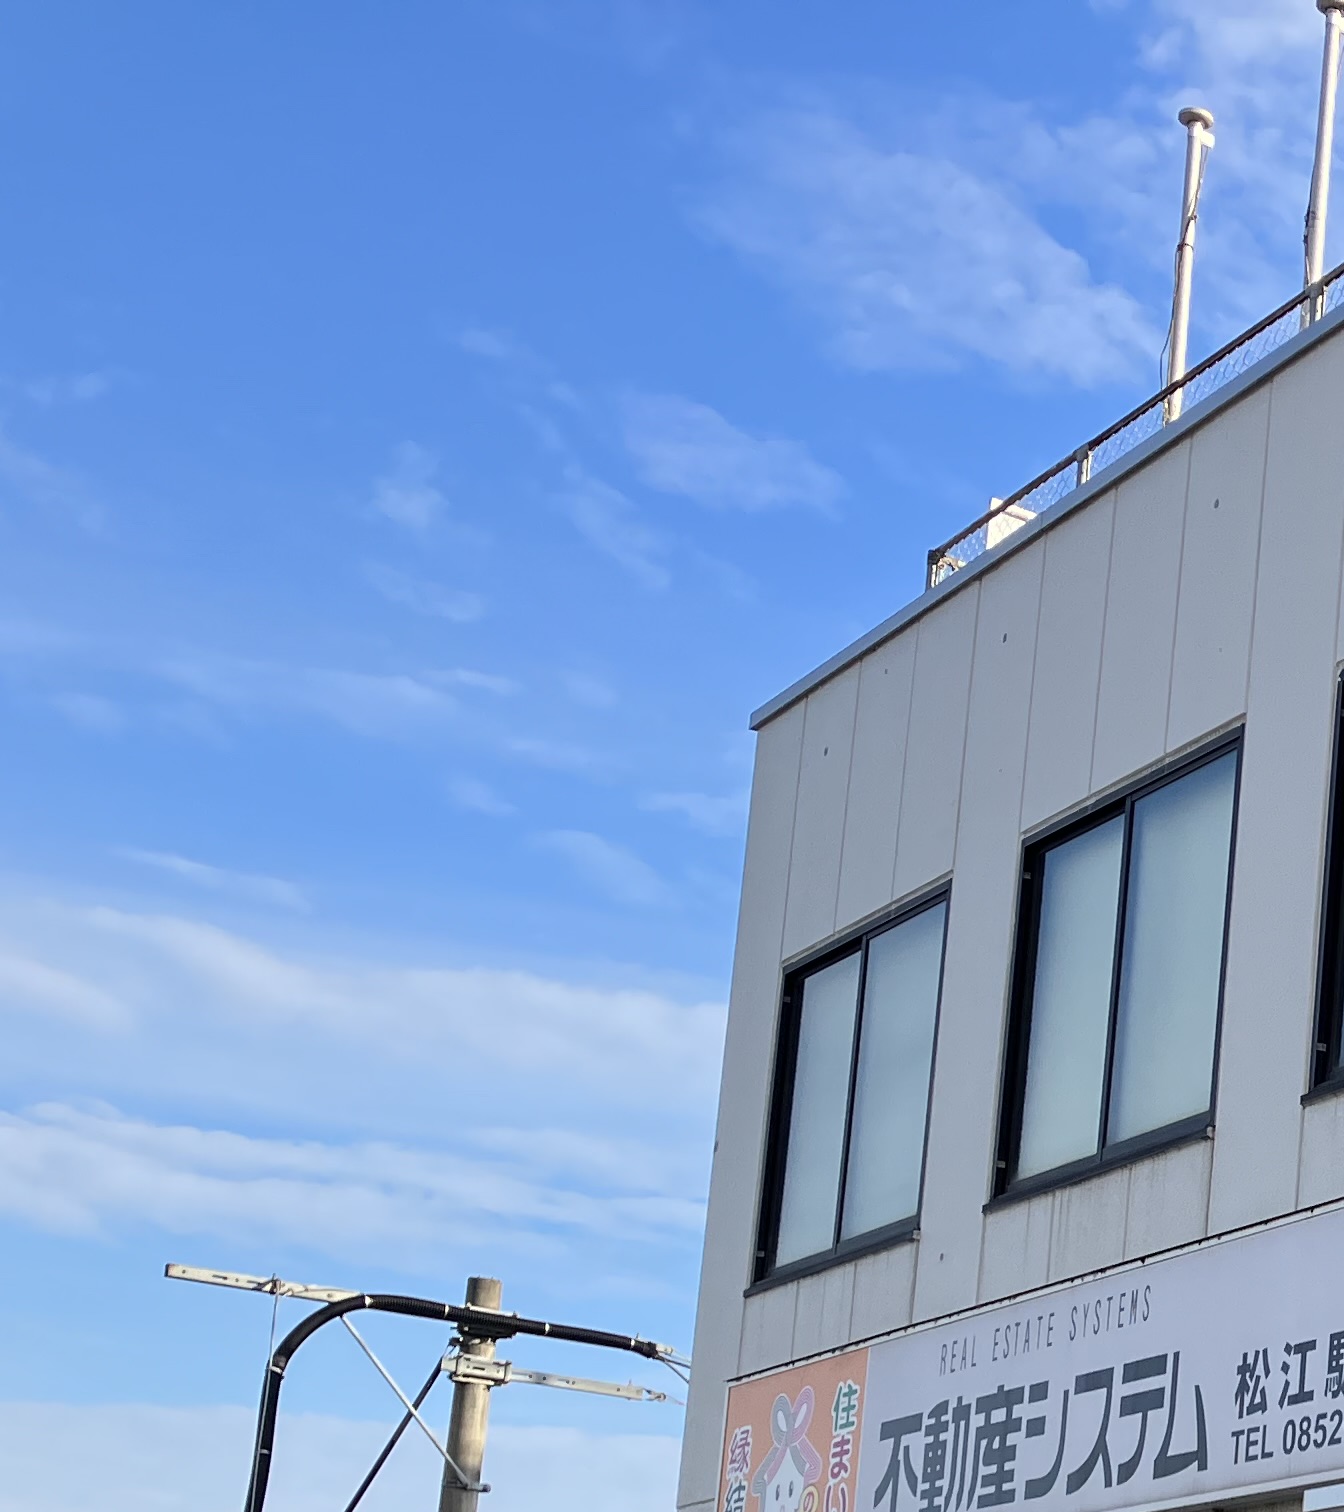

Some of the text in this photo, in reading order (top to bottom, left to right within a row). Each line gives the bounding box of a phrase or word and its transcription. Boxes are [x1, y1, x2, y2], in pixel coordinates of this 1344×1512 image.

[939, 1285, 1152, 1376] REAL ESTATE SYSTEMS
[1231, 1425, 1274, 1465] TEL
